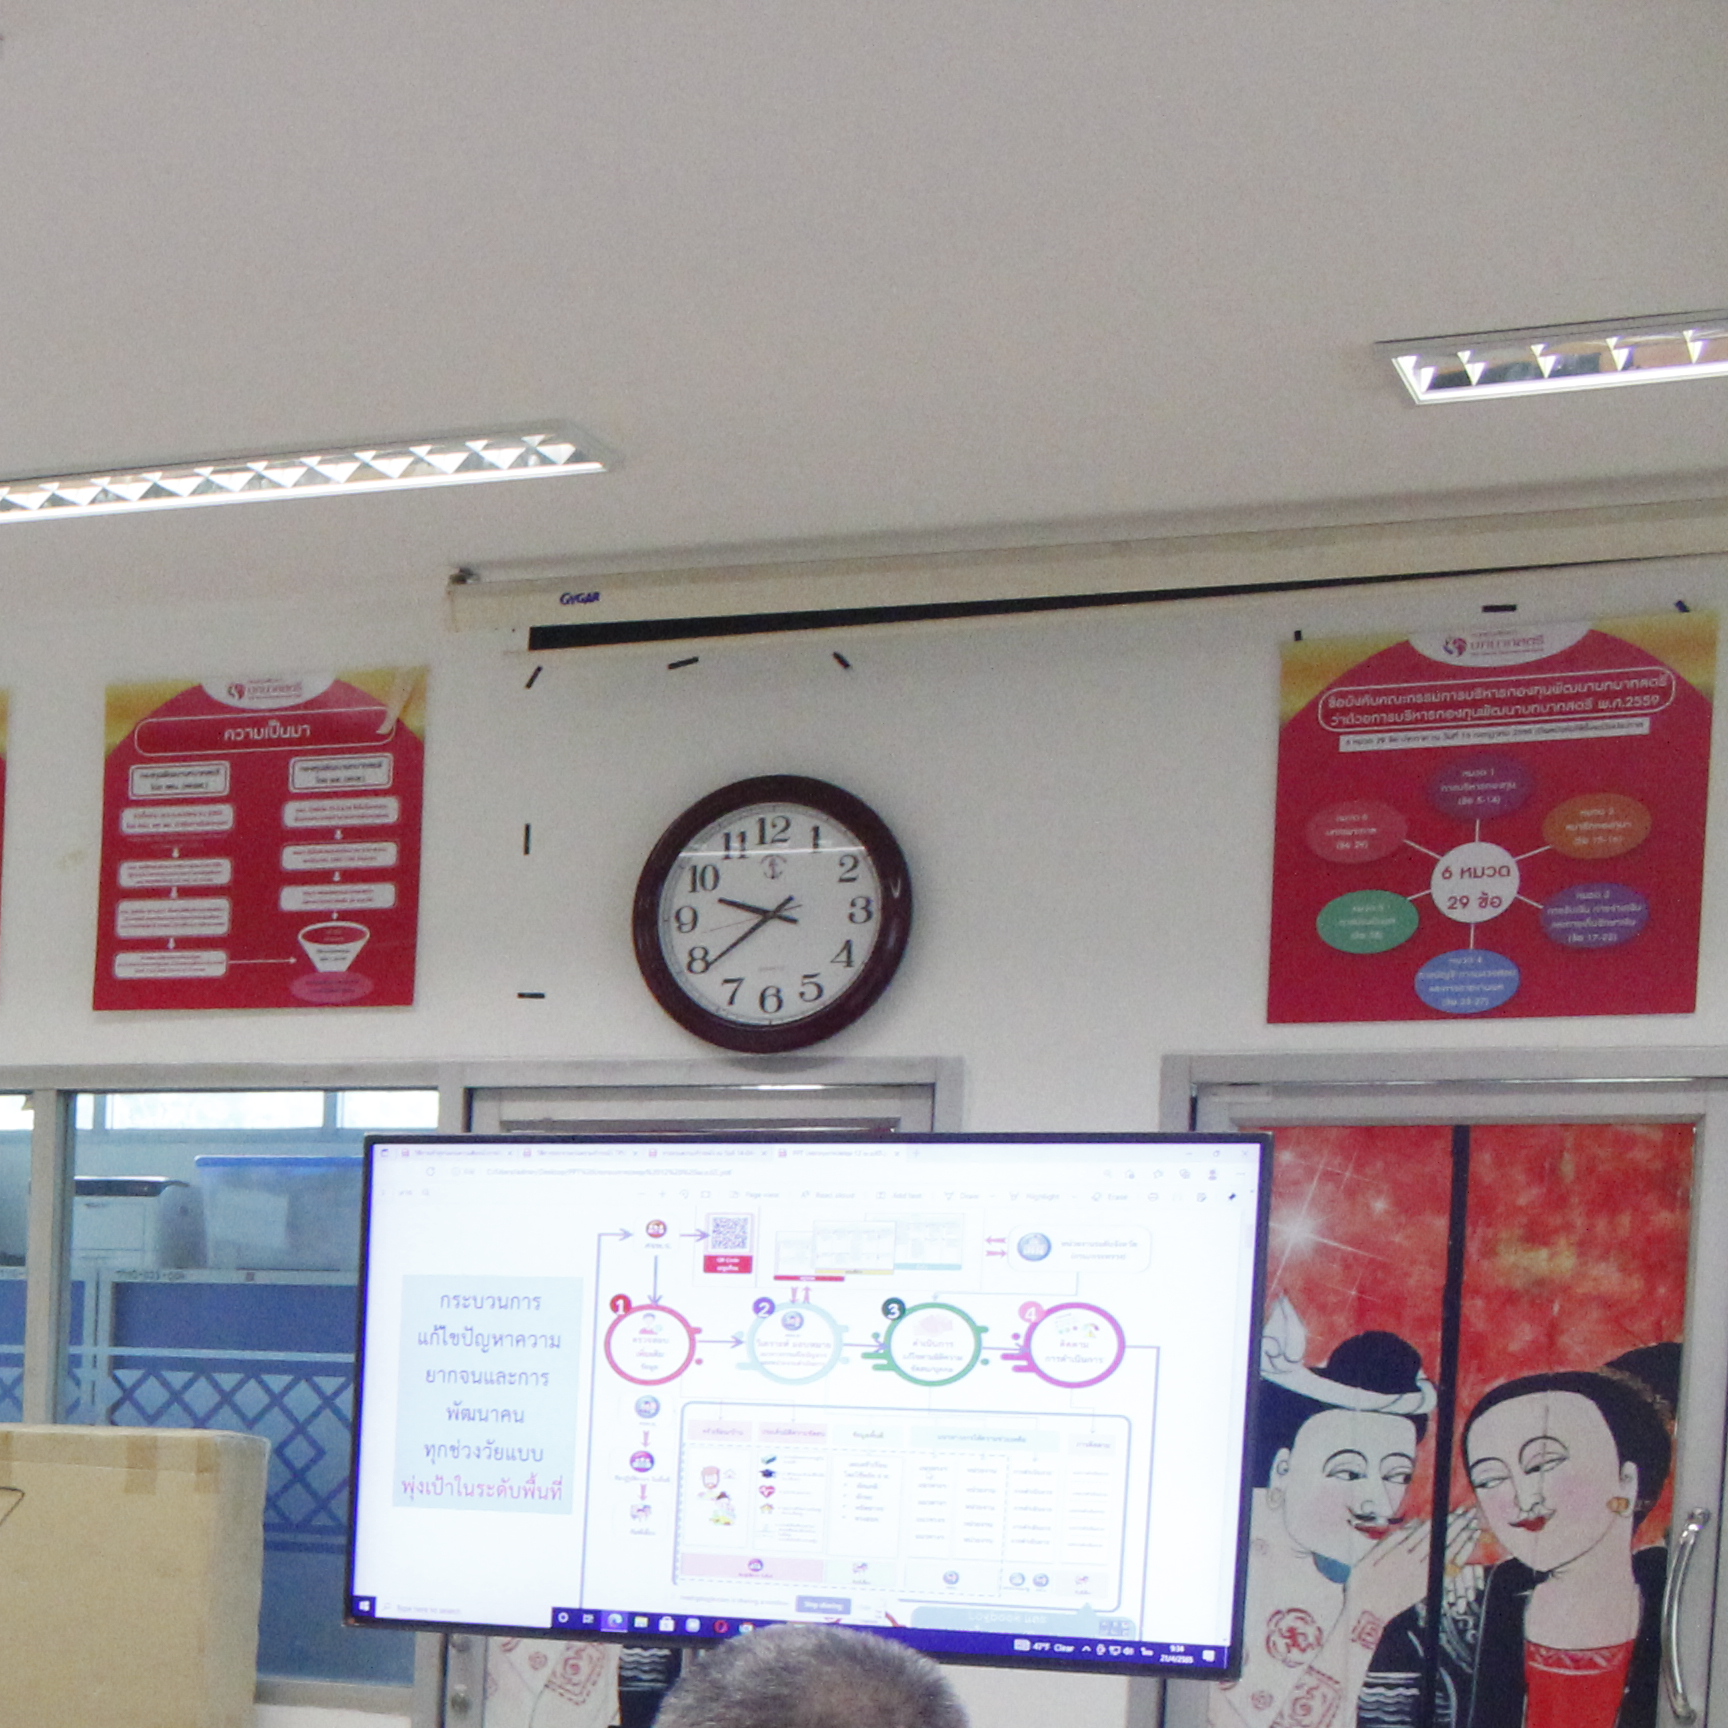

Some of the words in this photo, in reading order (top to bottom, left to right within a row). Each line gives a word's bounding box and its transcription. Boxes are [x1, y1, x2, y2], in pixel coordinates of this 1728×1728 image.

[224, 720, 311, 741] ความเป็นมา
[756, 816, 791, 846] 12
[809, 826, 822, 854] 1
[722, 830, 749, 860] 11
[688, 864, 720, 892] 10
[838, 854, 860, 882] 2
[1441, 865, 1453, 879] 6
[1460, 865, 1511, 879] หมวด
[848, 896, 873, 924] 3
[1447, 896, 1470, 910] 29
[1477, 892, 1503, 909] ข้อ
[675, 906, 698, 933] 9
[687, 946, 710, 974] 8
[830, 939, 854, 968] 4
[722, 977, 745, 1006] 7
[759, 986, 784, 1014] 6
[799, 972, 824, 1002] 5
[440, 1294, 541, 1311] กระบวนการ
[615, 1299, 625, 1315] 1
[759, 1302, 770, 1318] 2
[887, 1302, 901, 1320] 3
[1024, 1307, 1037, 1322] 4
[418, 1324, 561, 1353] แก้ไขปัญหาความ
[425, 1369, 549, 1386] ยากจนและการ
[446, 1399, 524, 1424] พัฒนาคน
[424, 1439, 543, 1465] ทุกช่วงวัยแบบ
[401, 1471, 563, 1501] พุ่งเป้าในระดับพื้นที่
[968, 1610, 1009, 1624] Logbook
[1054, 1644, 1075, 1653] Clear
